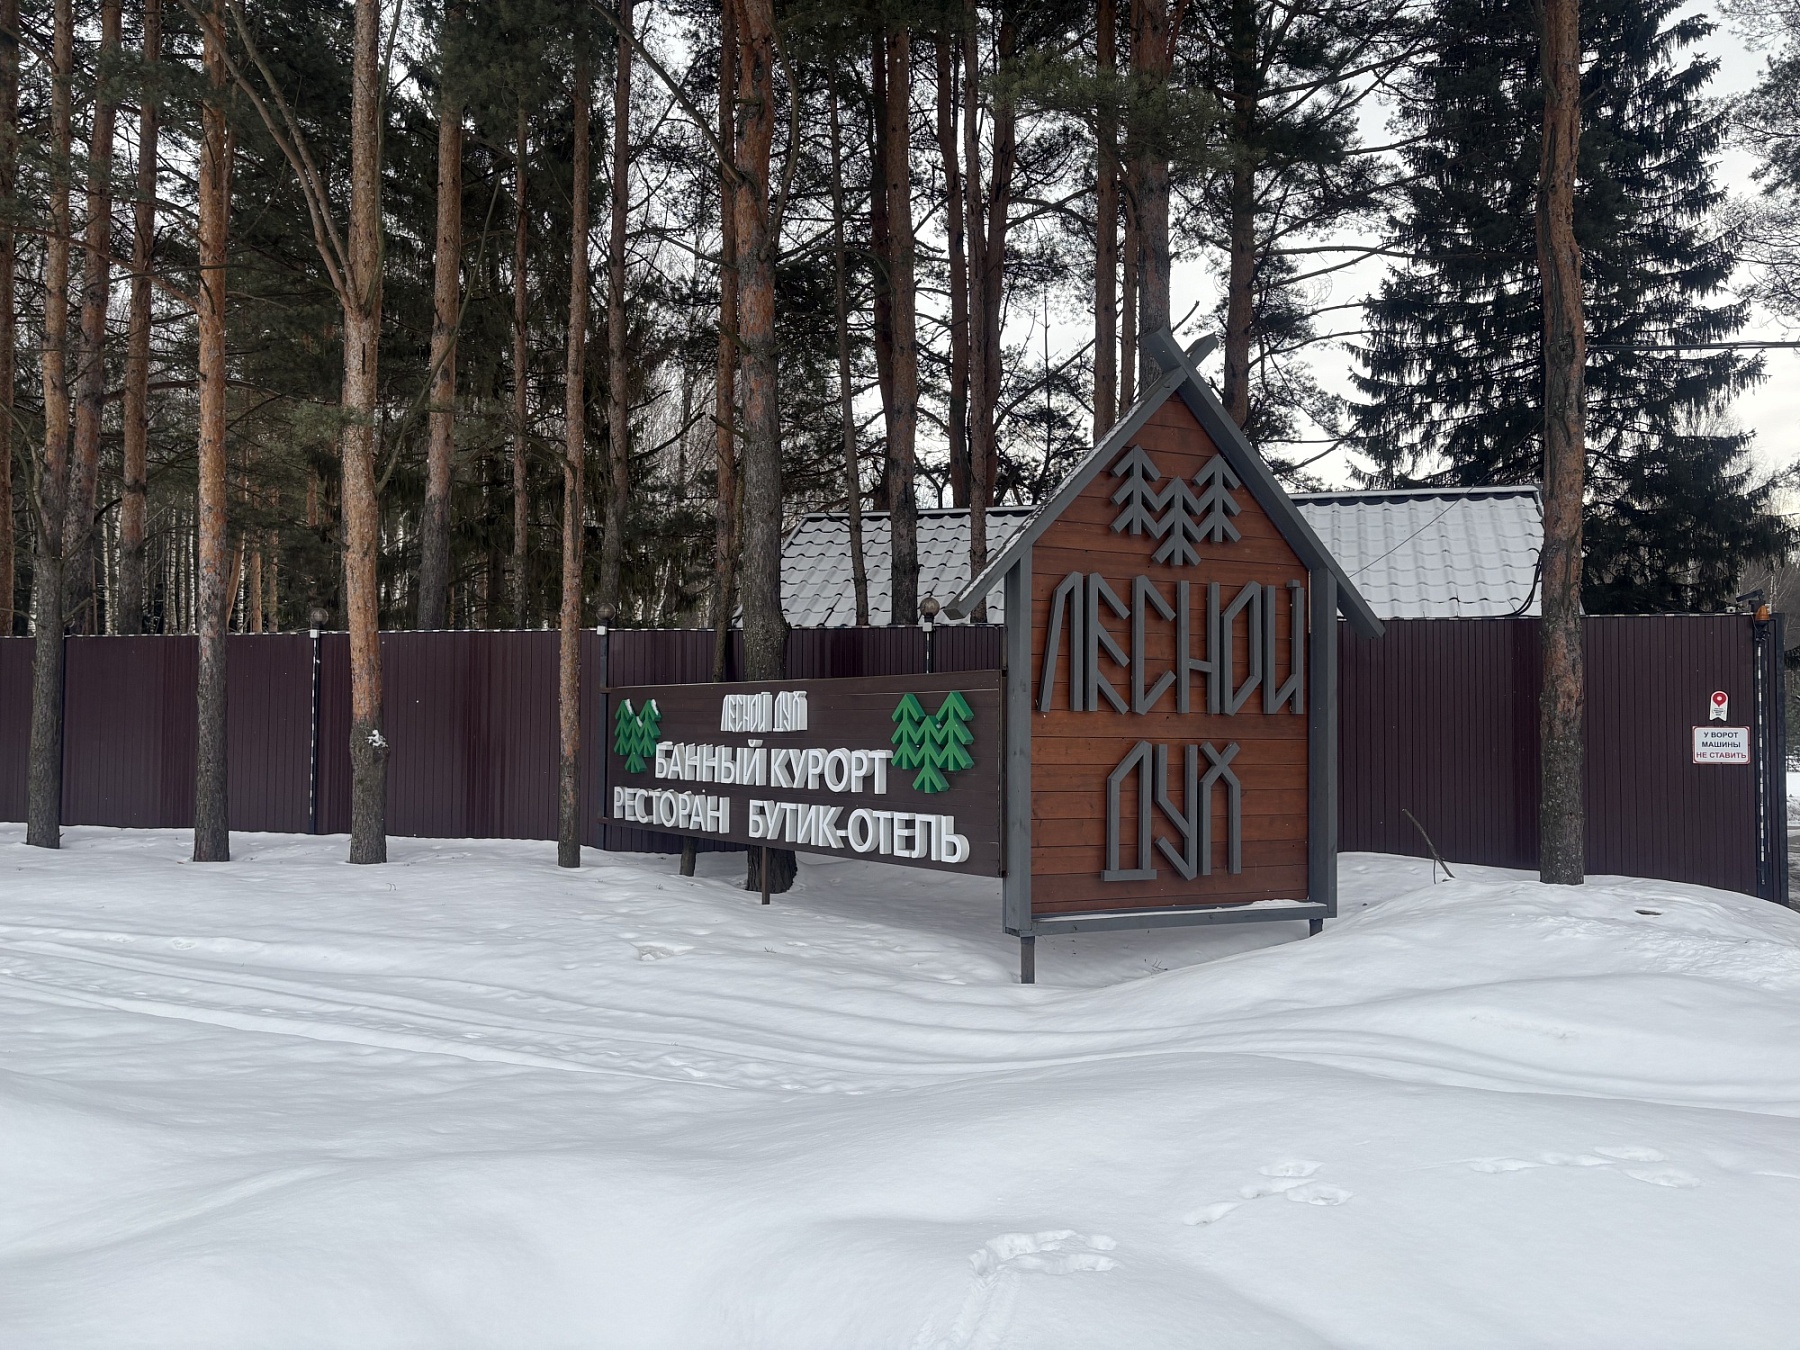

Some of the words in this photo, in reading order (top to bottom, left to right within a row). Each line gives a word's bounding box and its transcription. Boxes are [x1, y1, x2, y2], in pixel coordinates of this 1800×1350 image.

[1036, 571, 1304, 716] ЛЕСНОЙ
[773, 690, 808, 732] ДУХ
[655, 738, 767, 786] БАННЫЙ
[770, 747, 893, 795] КУРОРТ
[613, 786, 730, 834] РЕСТОРАН
[748, 799, 971, 863] БУТИК-ОТЕЛЬ
[1102, 740, 1241, 882] ДУХ
